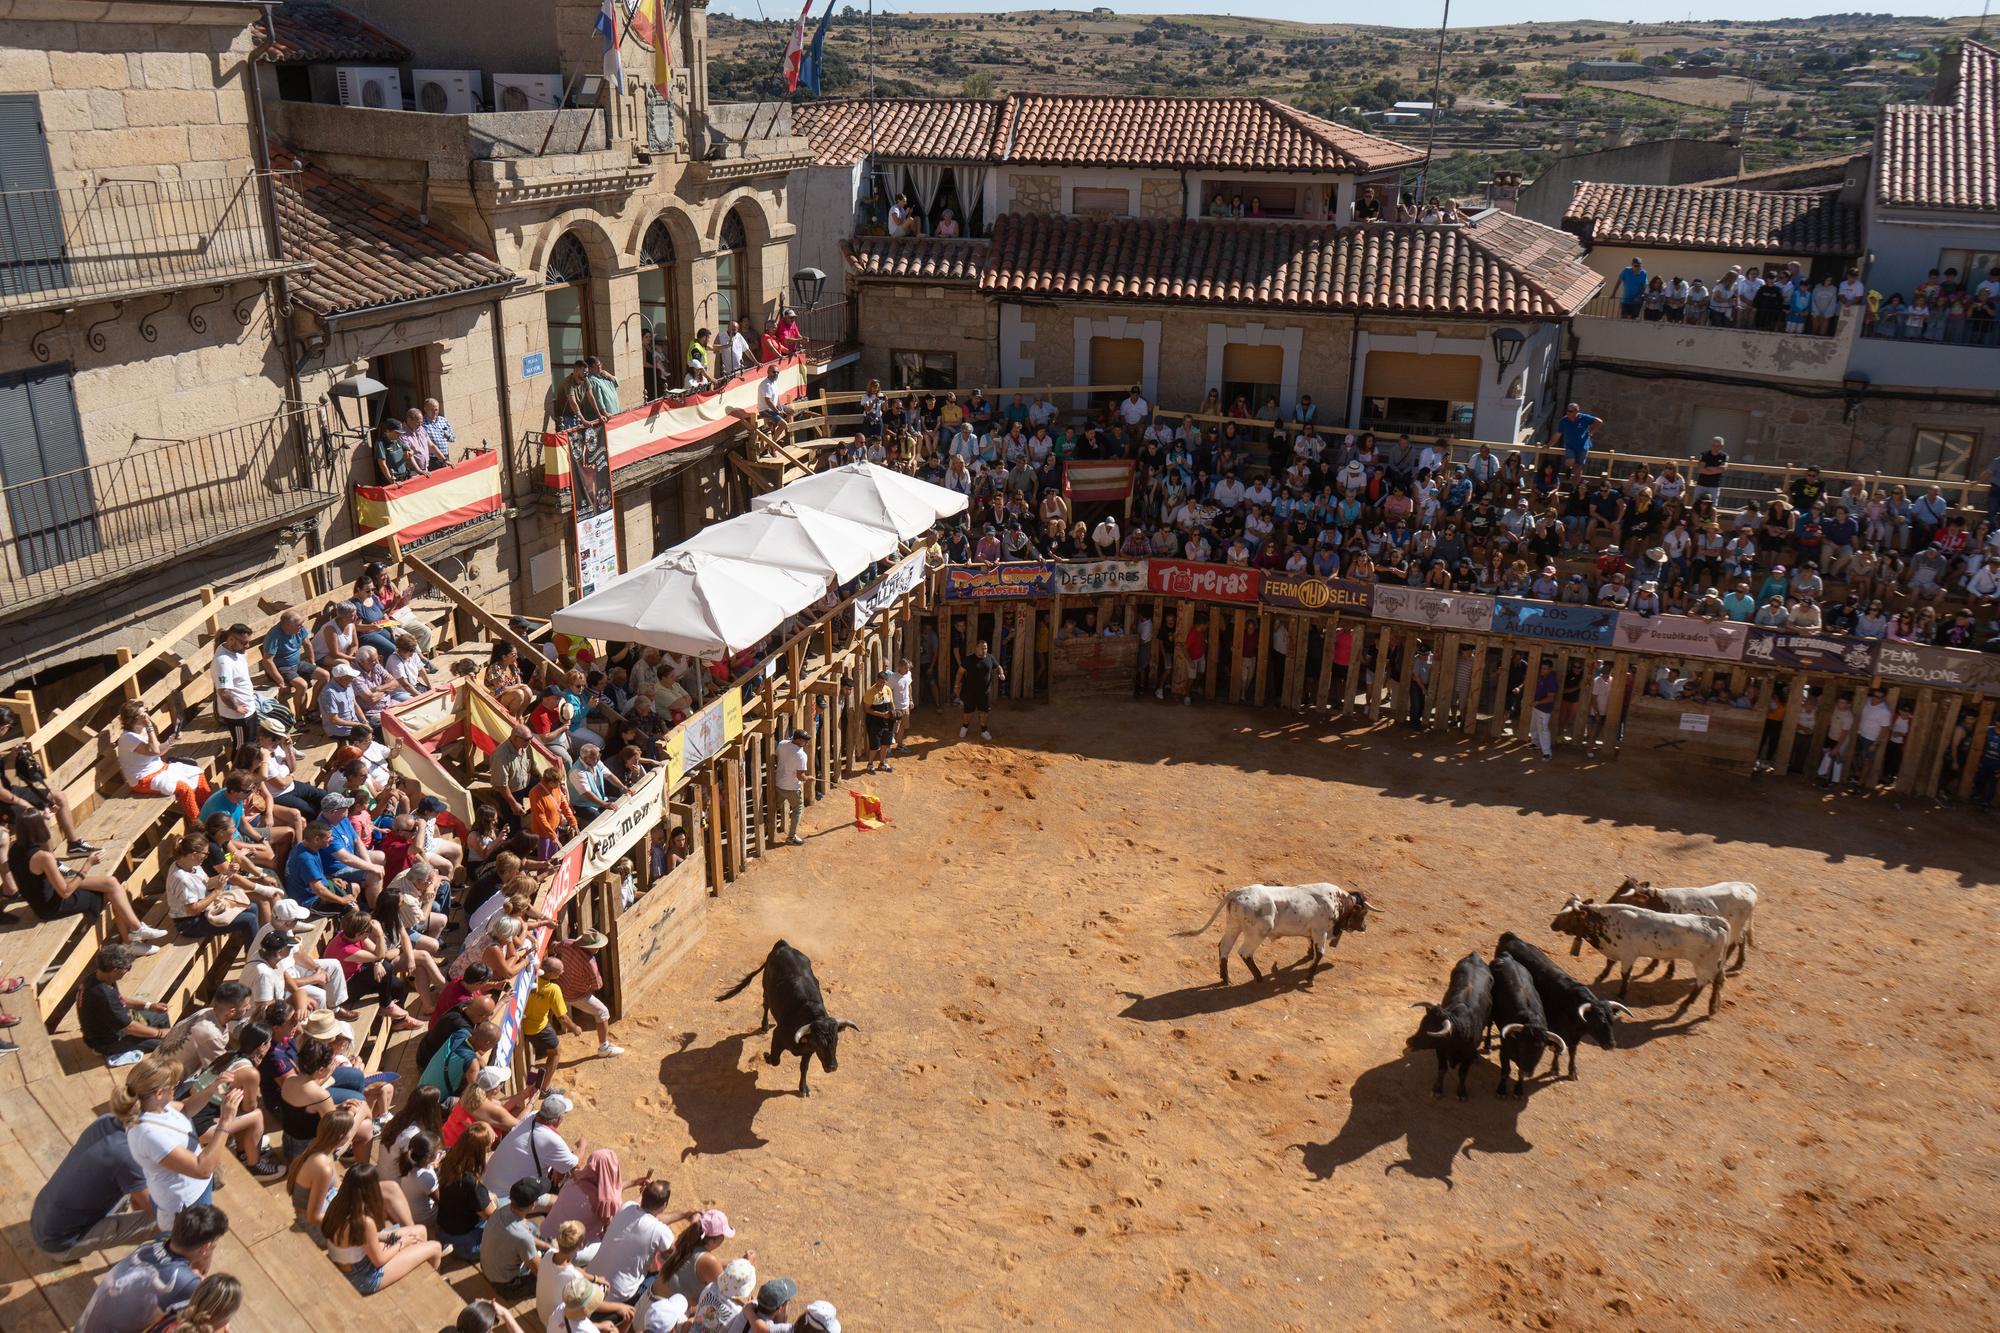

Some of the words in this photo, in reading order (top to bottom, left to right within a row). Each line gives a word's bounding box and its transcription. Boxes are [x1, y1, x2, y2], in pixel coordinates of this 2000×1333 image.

[1061, 570, 1140, 586] DESERTORES
[1544, 608, 1568, 621] LOS
[1504, 618, 1600, 642] AUTÓNOMOS
[1880, 647, 1919, 664] PEÑA
